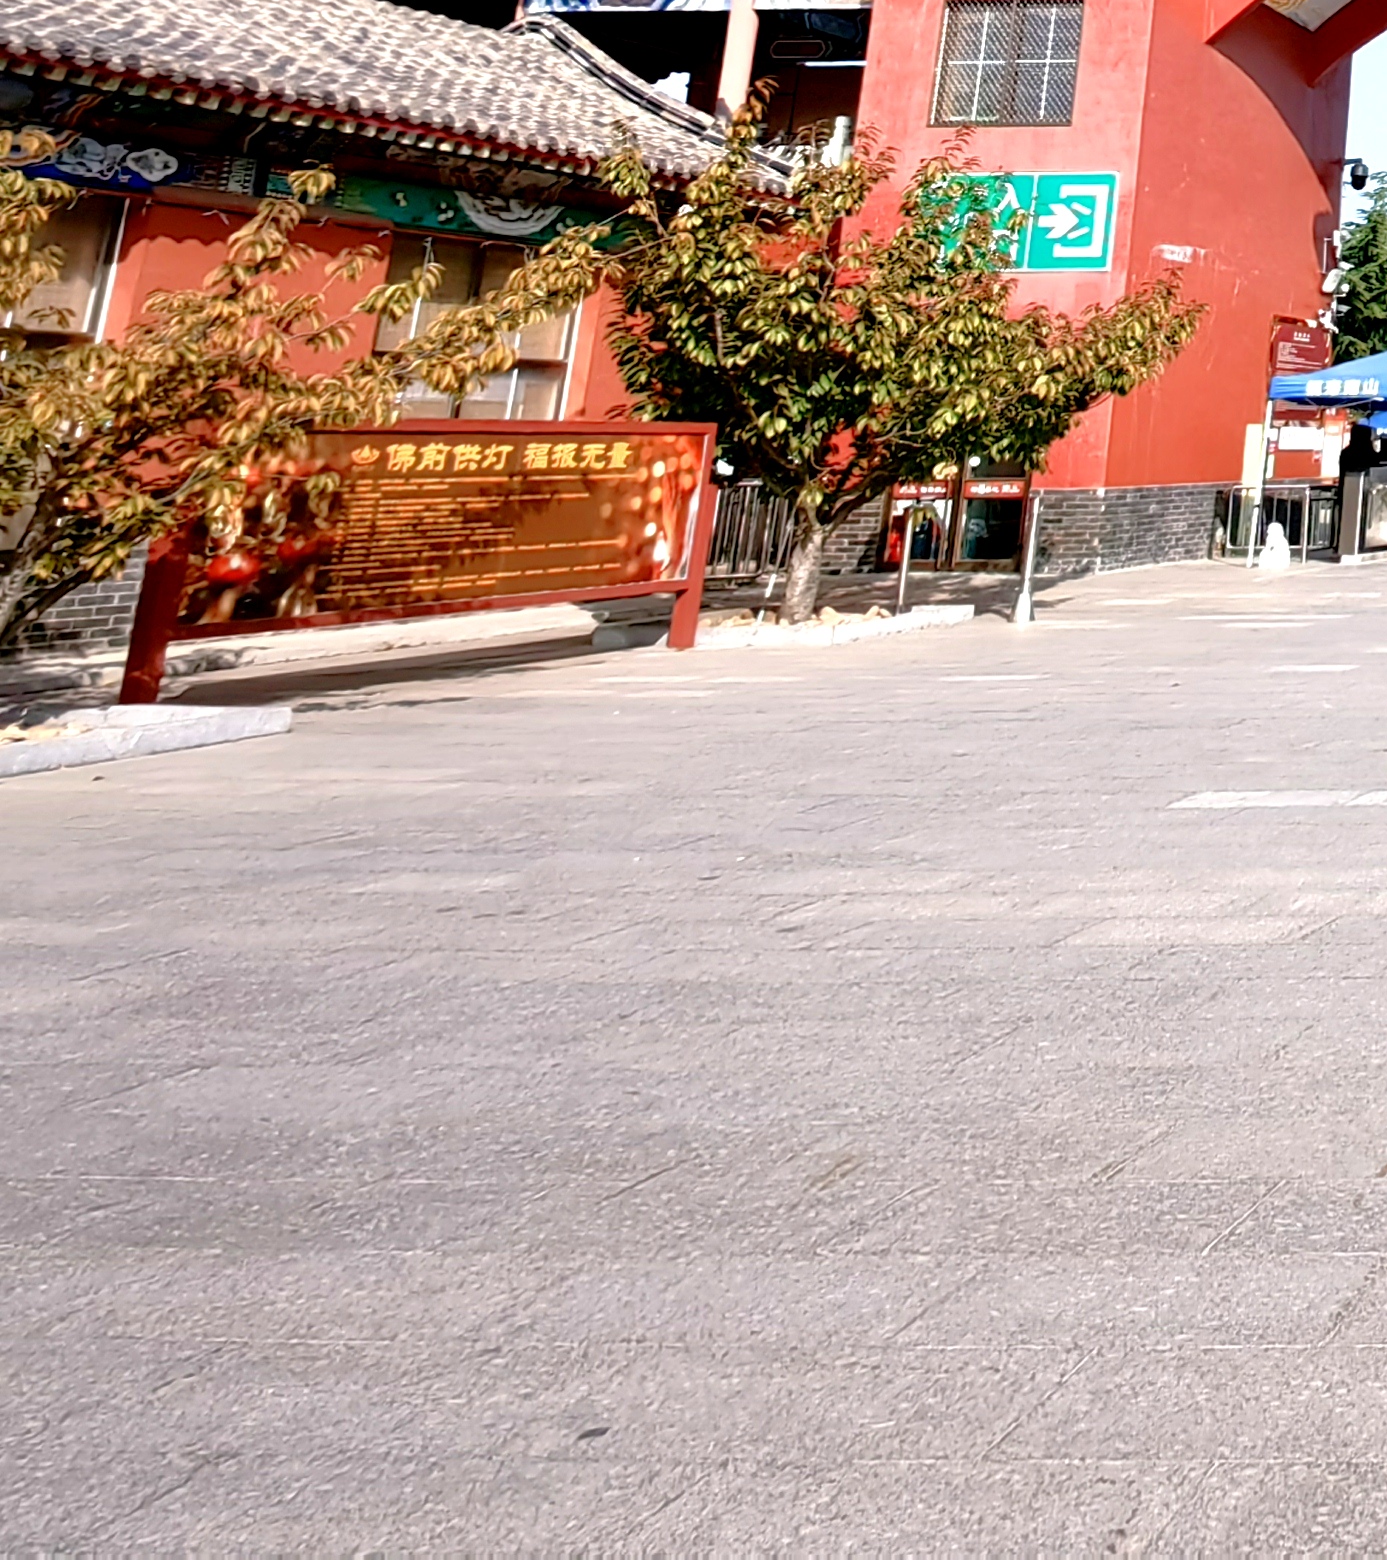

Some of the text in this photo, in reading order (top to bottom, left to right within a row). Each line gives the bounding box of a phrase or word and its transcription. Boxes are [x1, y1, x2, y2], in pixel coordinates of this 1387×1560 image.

[386, 442, 634, 471] 佛前供灯 福报无量
